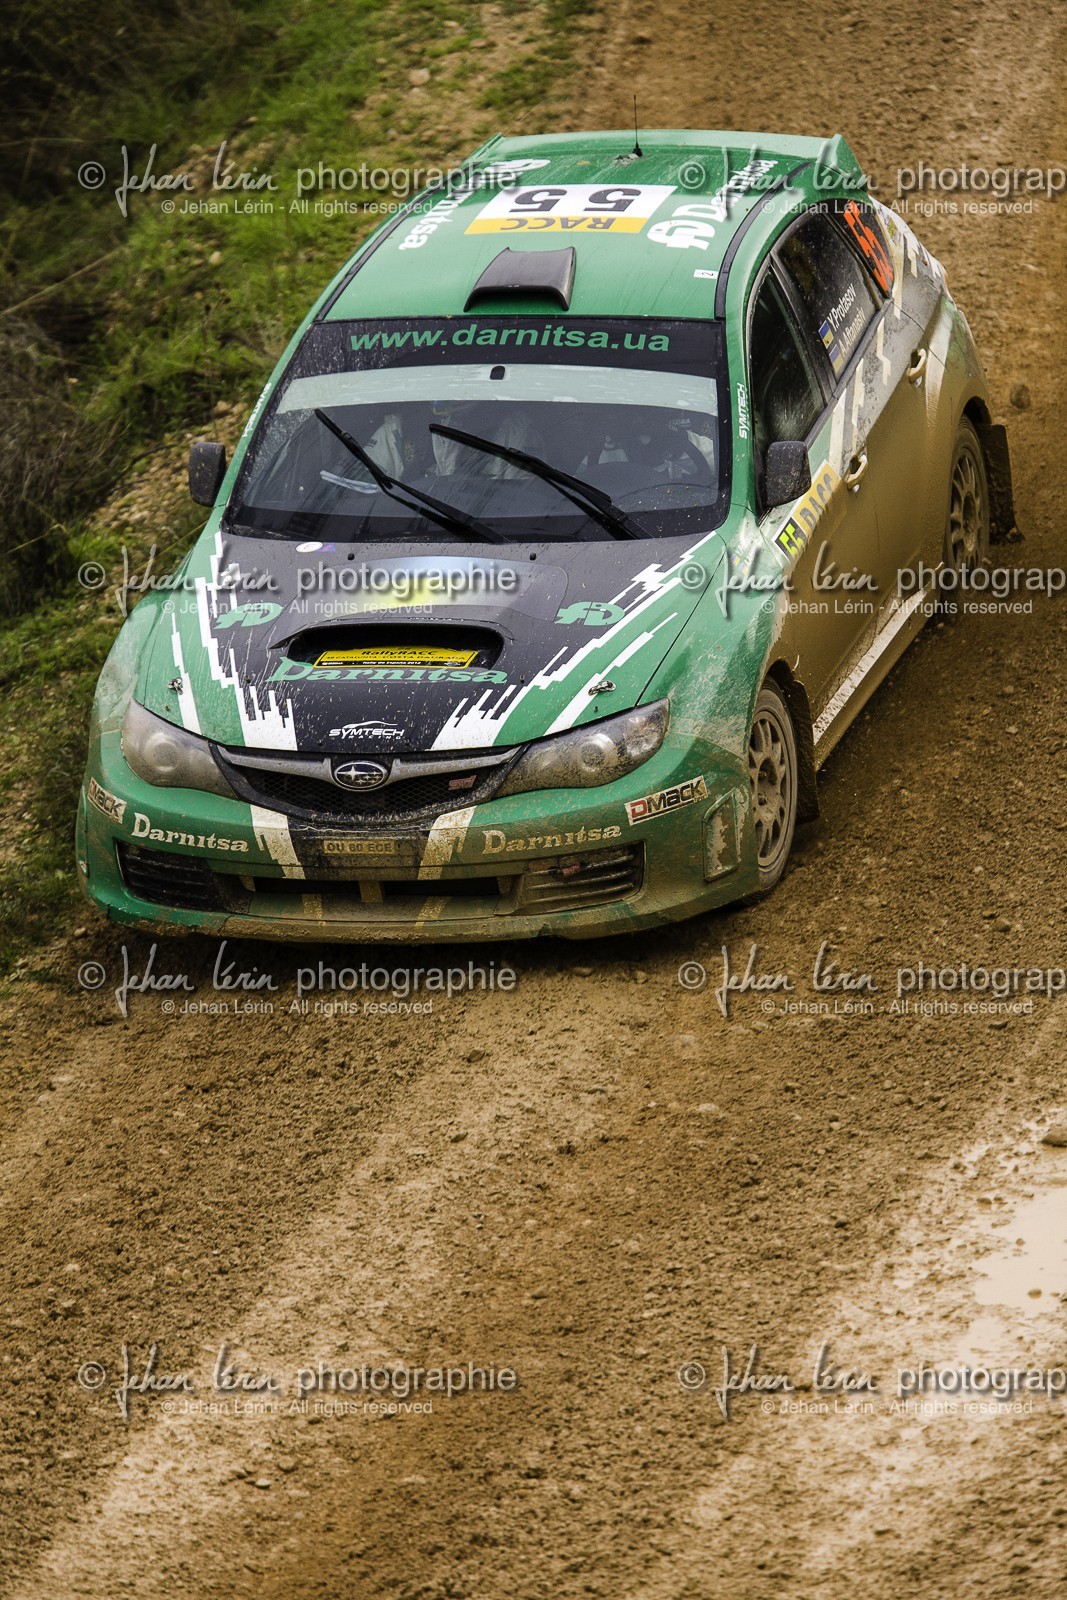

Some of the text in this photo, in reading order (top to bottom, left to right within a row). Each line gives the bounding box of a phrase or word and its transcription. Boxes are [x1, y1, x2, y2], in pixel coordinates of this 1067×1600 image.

[500, 216, 616, 232] RACC
[349, 323, 671, 353] www.darnitsa.ua
[738, 382, 748, 439] SYMTECH
[264, 655, 510, 684] Darnitsa
[328, 728, 405, 739] SYMTECH
[131, 811, 249, 853] Darnitsa
[481, 825, 623, 855] Darnitsa
